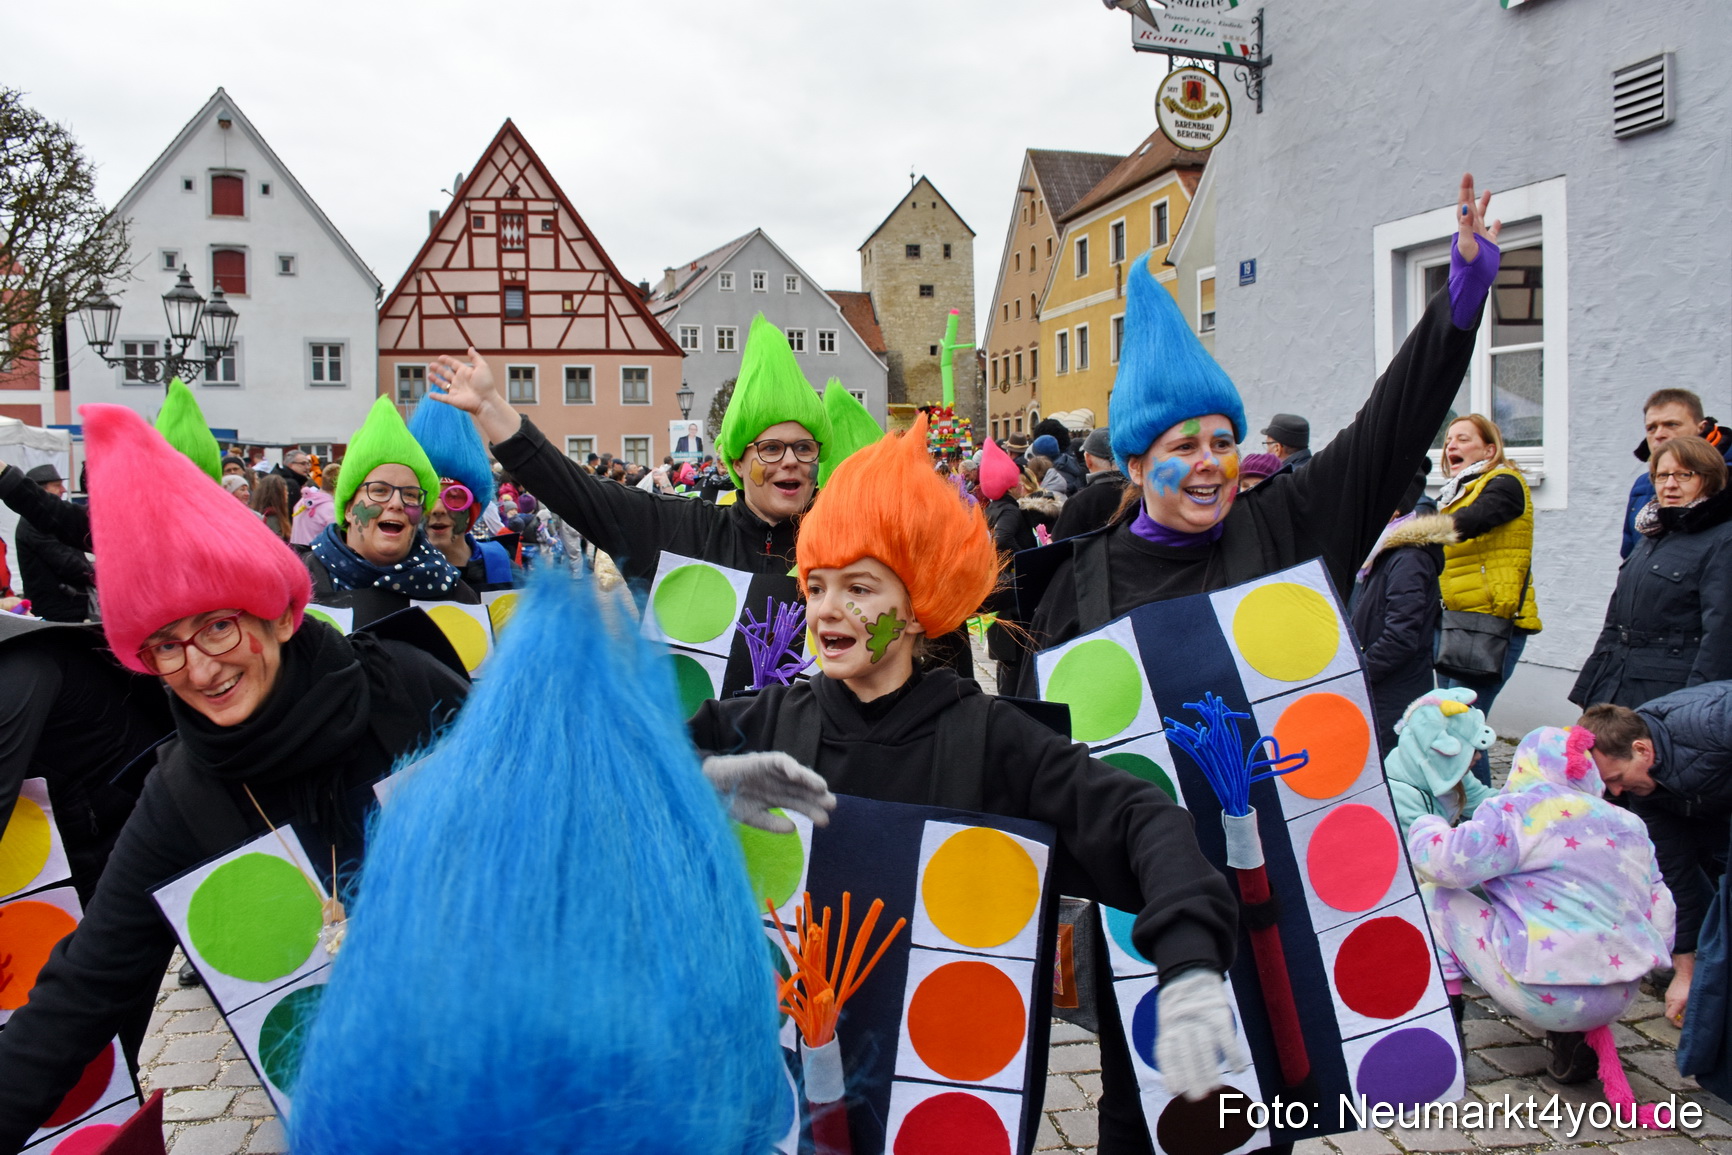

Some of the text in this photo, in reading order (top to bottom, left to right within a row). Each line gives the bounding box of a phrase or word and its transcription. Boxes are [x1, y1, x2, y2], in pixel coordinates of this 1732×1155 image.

[1171, 24, 1214, 37] Bella
[1140, 31, 1188, 44] Roma
[1177, 130, 1211, 140] BERCHING
